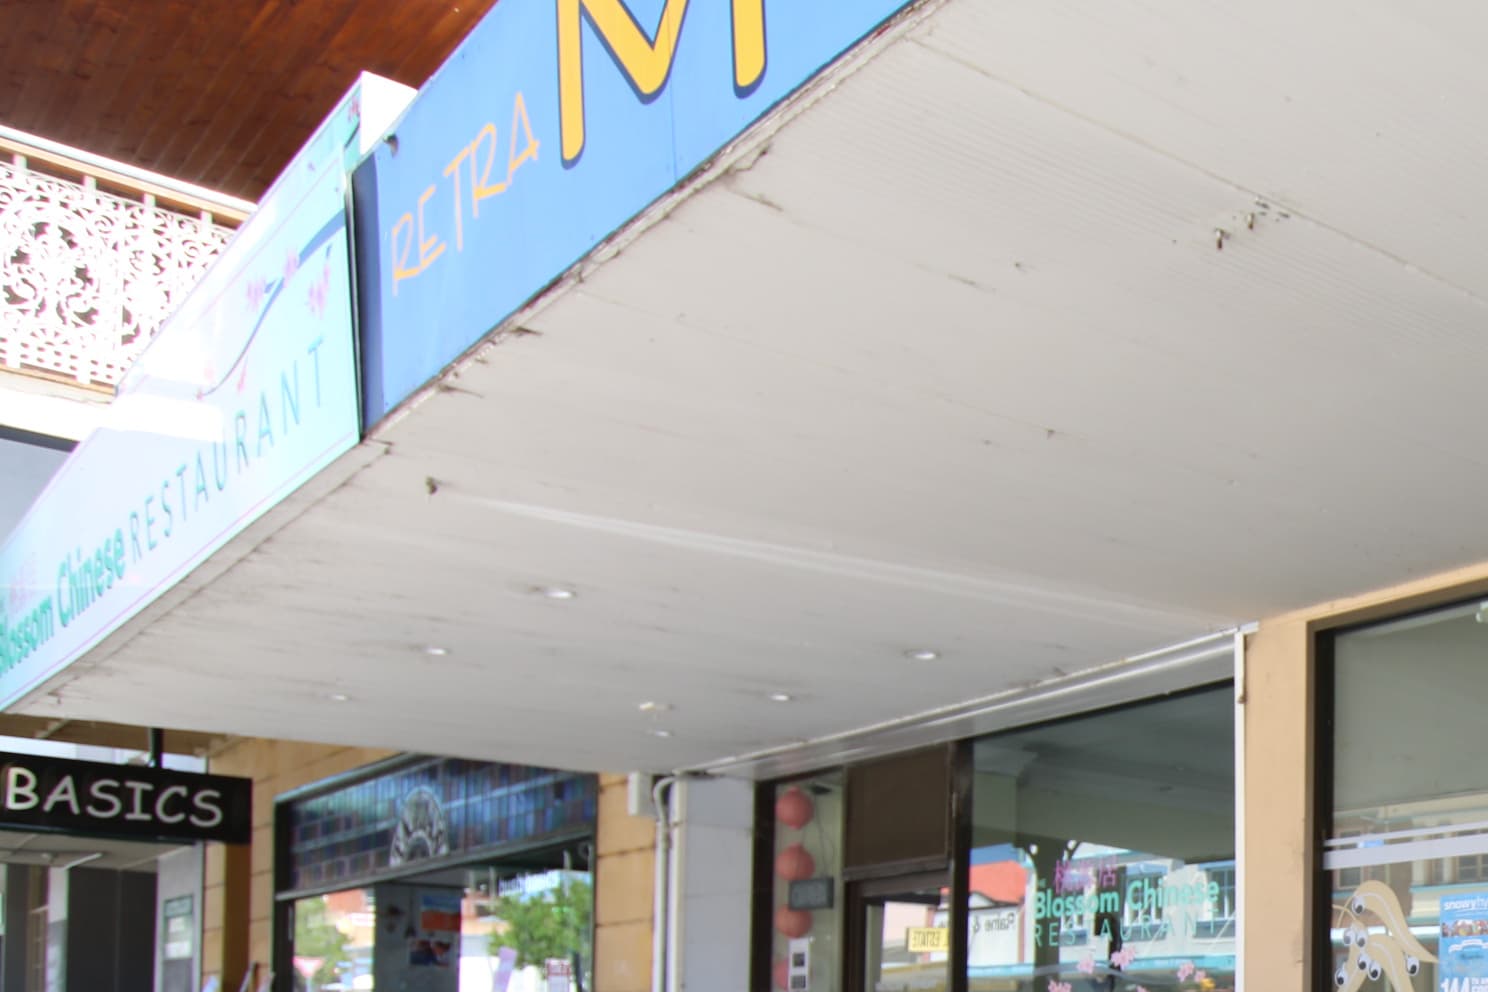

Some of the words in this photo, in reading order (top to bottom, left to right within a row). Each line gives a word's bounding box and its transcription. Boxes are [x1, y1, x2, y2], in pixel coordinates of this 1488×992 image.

[57, 528, 125, 627] Chinese
[129, 336, 323, 564] RESTAURANT
[6, 765, 223, 827] BASICS
[1035, 888, 1119, 919] Blossom
[1127, 877, 1220, 911] Chinese
[1034, 908, 1219, 947] RESAURANT
